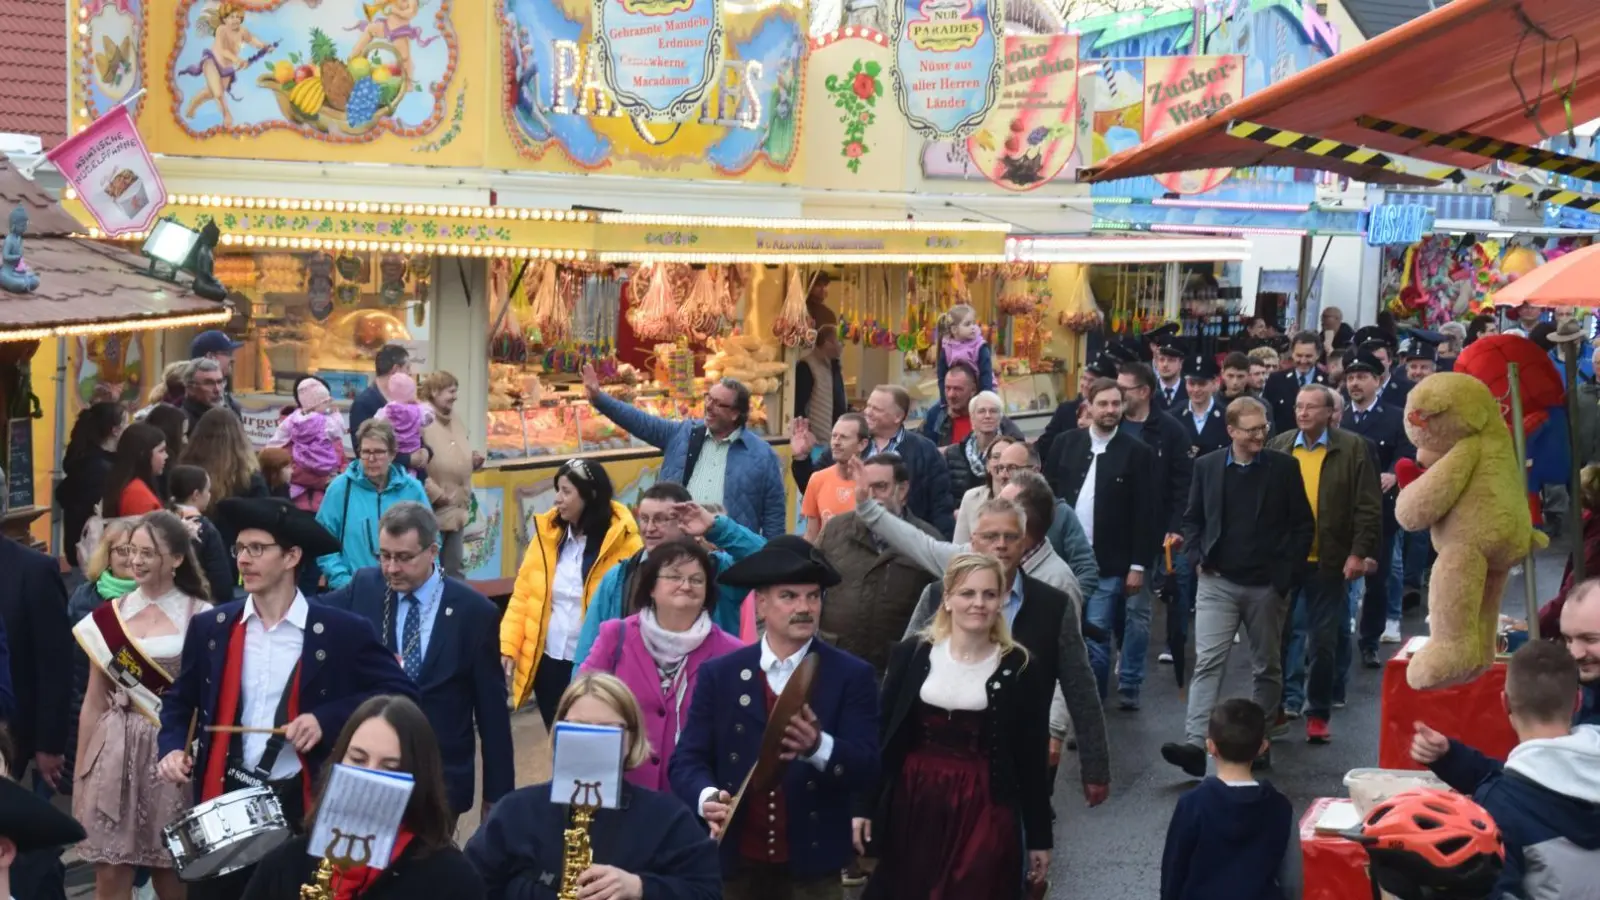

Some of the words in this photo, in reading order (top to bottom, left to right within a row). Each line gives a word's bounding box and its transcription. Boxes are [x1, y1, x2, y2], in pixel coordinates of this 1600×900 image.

[609, 23, 662, 39] Gebrannte
[665, 16, 709, 31] Mandeln
[914, 23, 979, 35] PARADIES
[658, 37, 704, 49] Erdnüsse
[1005, 43, 1048, 63] oko
[920, 60, 950, 72] Nüsse
[954, 61, 973, 71] aus
[632, 75, 690, 88] Macadamia
[912, 79, 936, 91] aller
[940, 77, 980, 90] Herren
[1147, 63, 1237, 106] Zucker-
[927, 96, 966, 109] Länder
[75, 131, 125, 170] ASIATISCHE
[75, 138, 137, 185] NUDELPFANNE
[234, 770, 263, 787] SONOR
